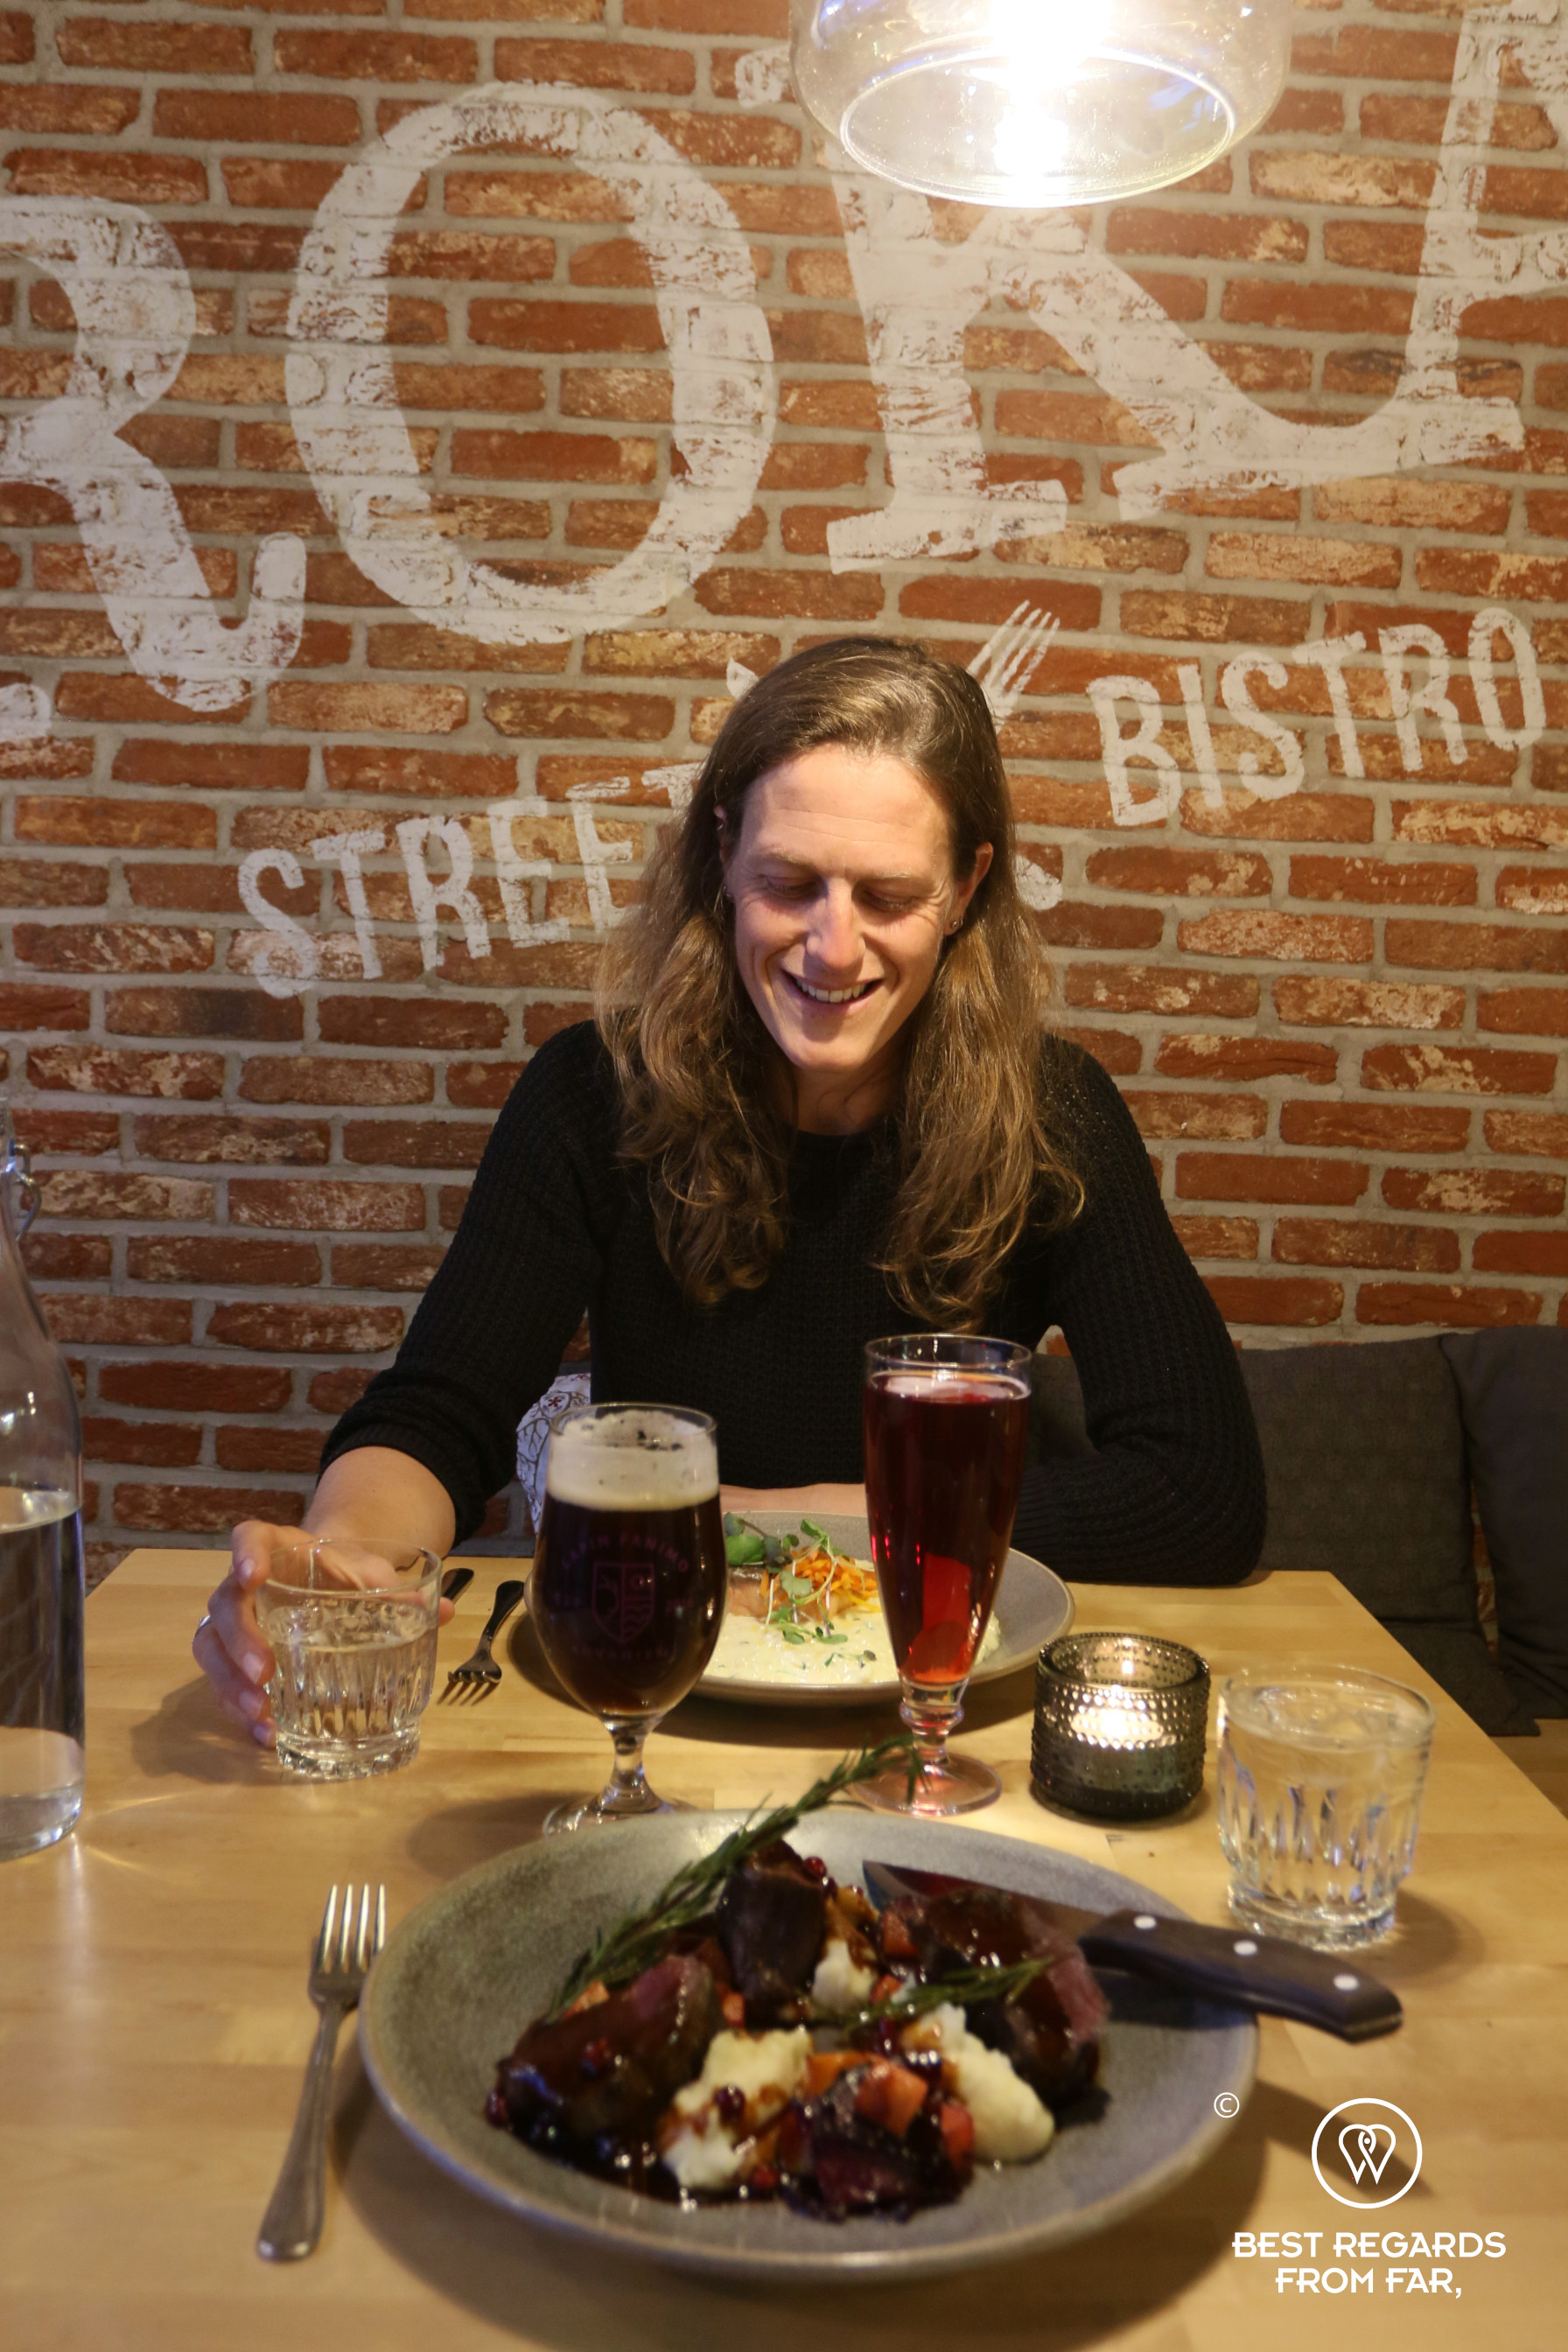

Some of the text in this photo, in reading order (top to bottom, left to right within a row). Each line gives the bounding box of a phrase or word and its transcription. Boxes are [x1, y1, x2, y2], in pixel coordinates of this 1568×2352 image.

[237, 607, 1545, 999] STREE BISTRO
[619, 1532, 690, 1572] PANIMO
